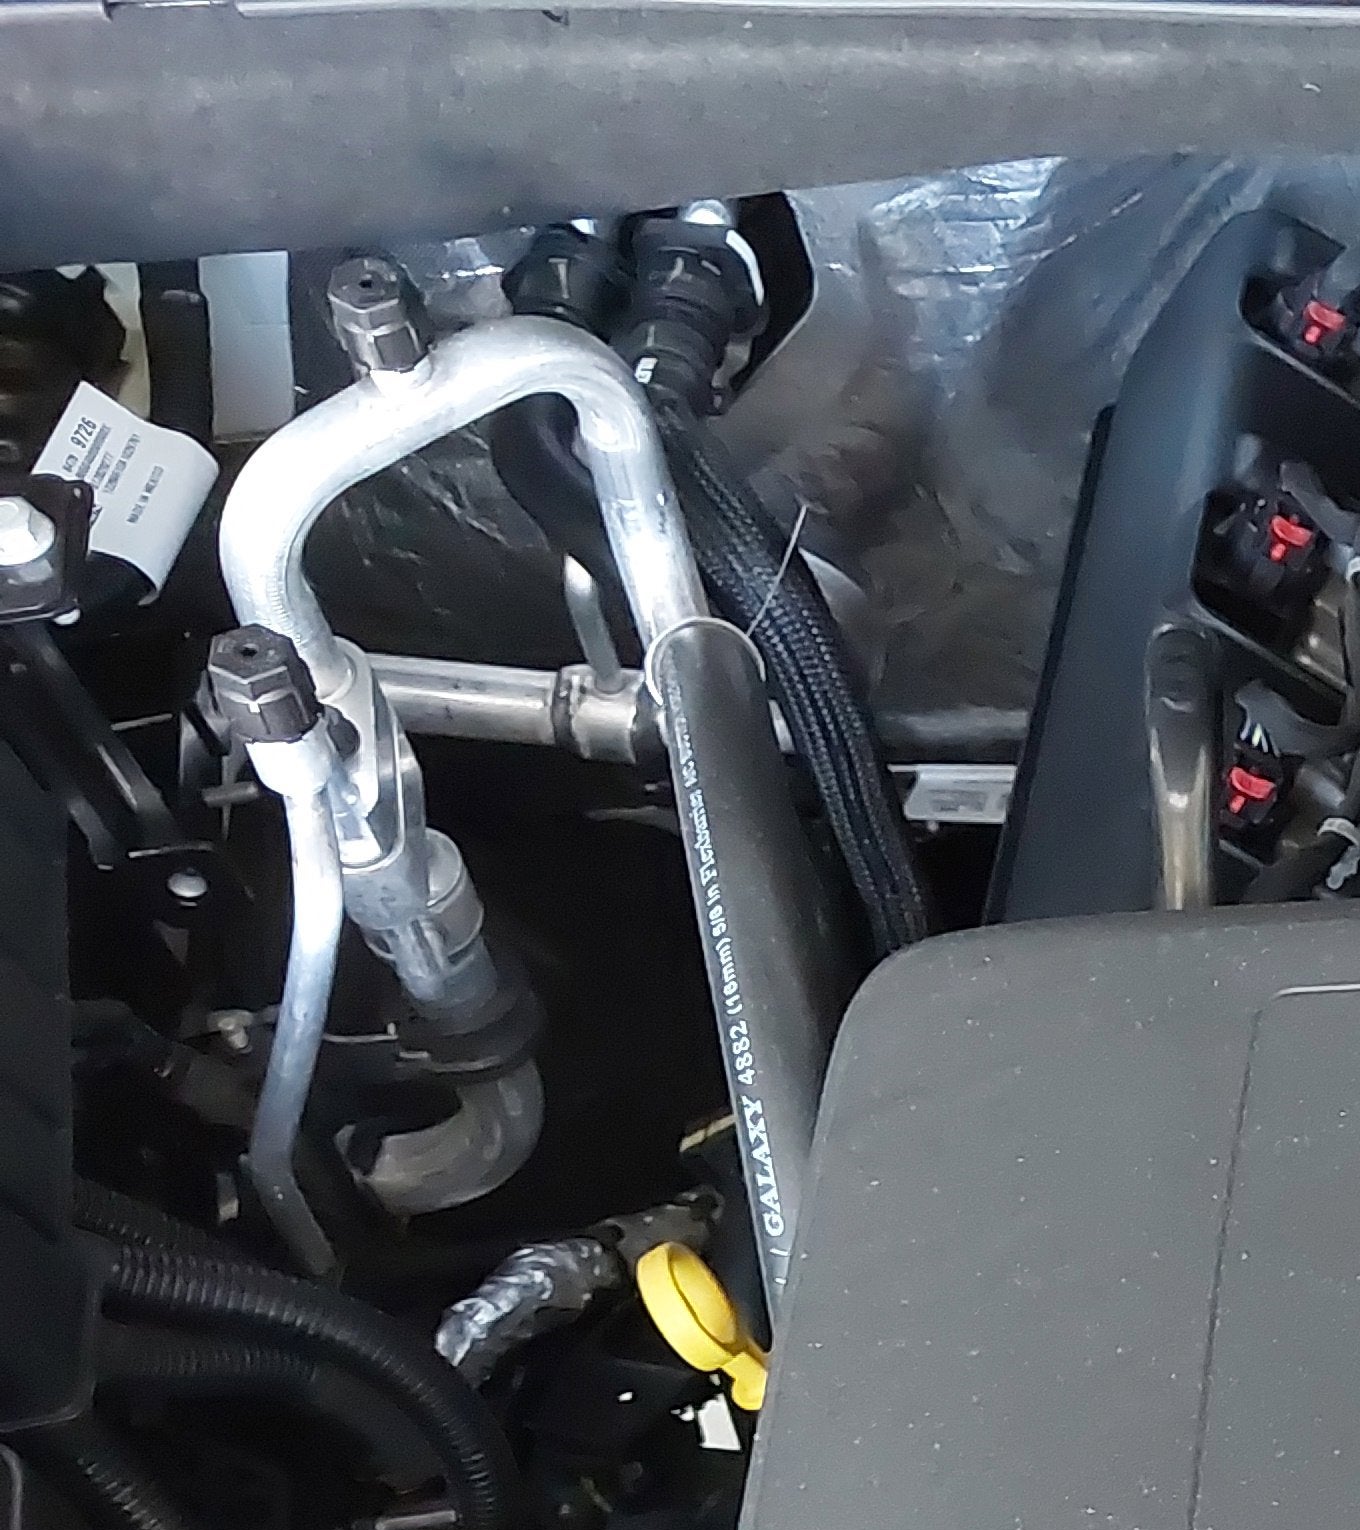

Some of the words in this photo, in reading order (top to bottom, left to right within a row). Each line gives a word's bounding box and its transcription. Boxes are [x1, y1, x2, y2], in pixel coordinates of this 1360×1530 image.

[70, 417, 97, 449] 9726
[729, 1019, 754, 1085] 4882
[741, 1095, 785, 1237] GALAXY
